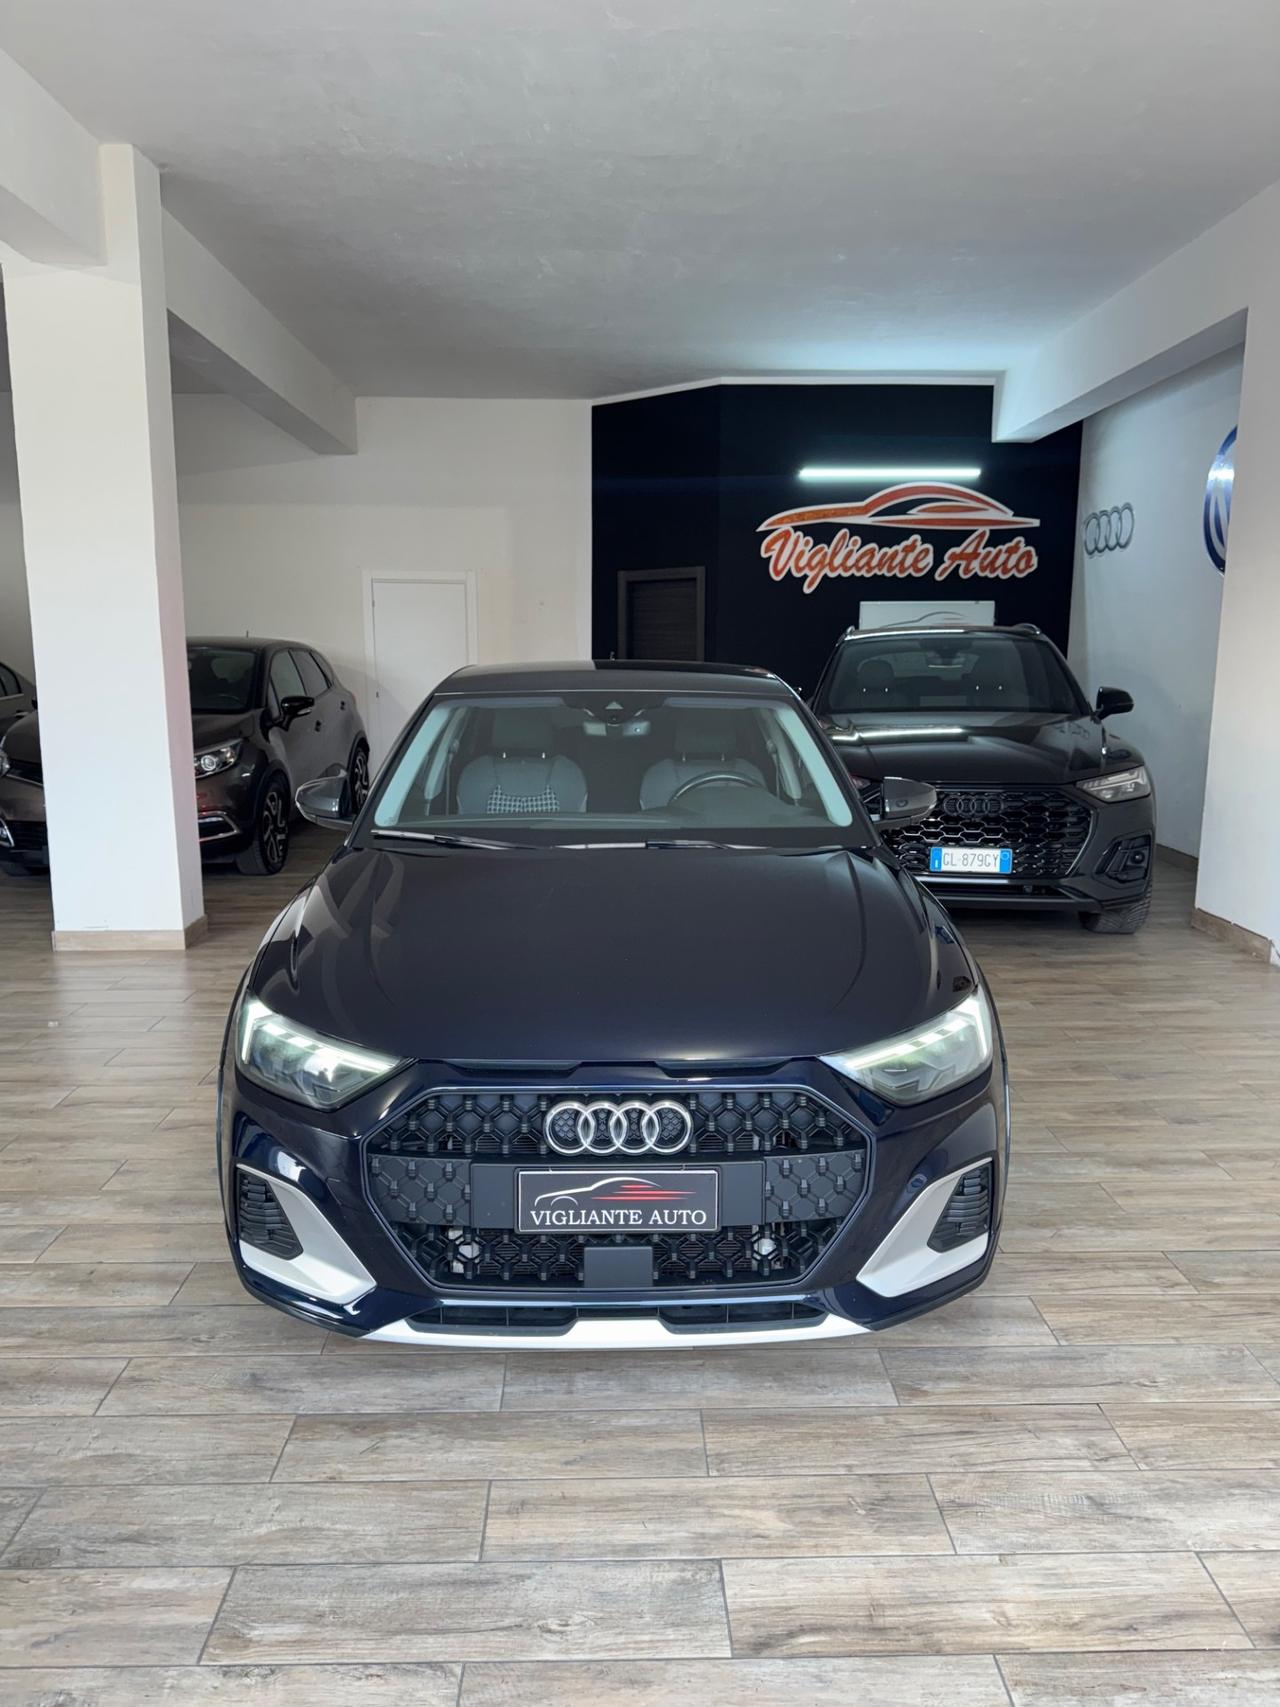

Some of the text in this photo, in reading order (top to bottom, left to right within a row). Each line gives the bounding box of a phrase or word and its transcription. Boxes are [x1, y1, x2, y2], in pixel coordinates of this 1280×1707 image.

[761, 527, 1038, 594] Vigliante Auto
[530, 1210, 707, 1225] VIGLIANTE AUTO
